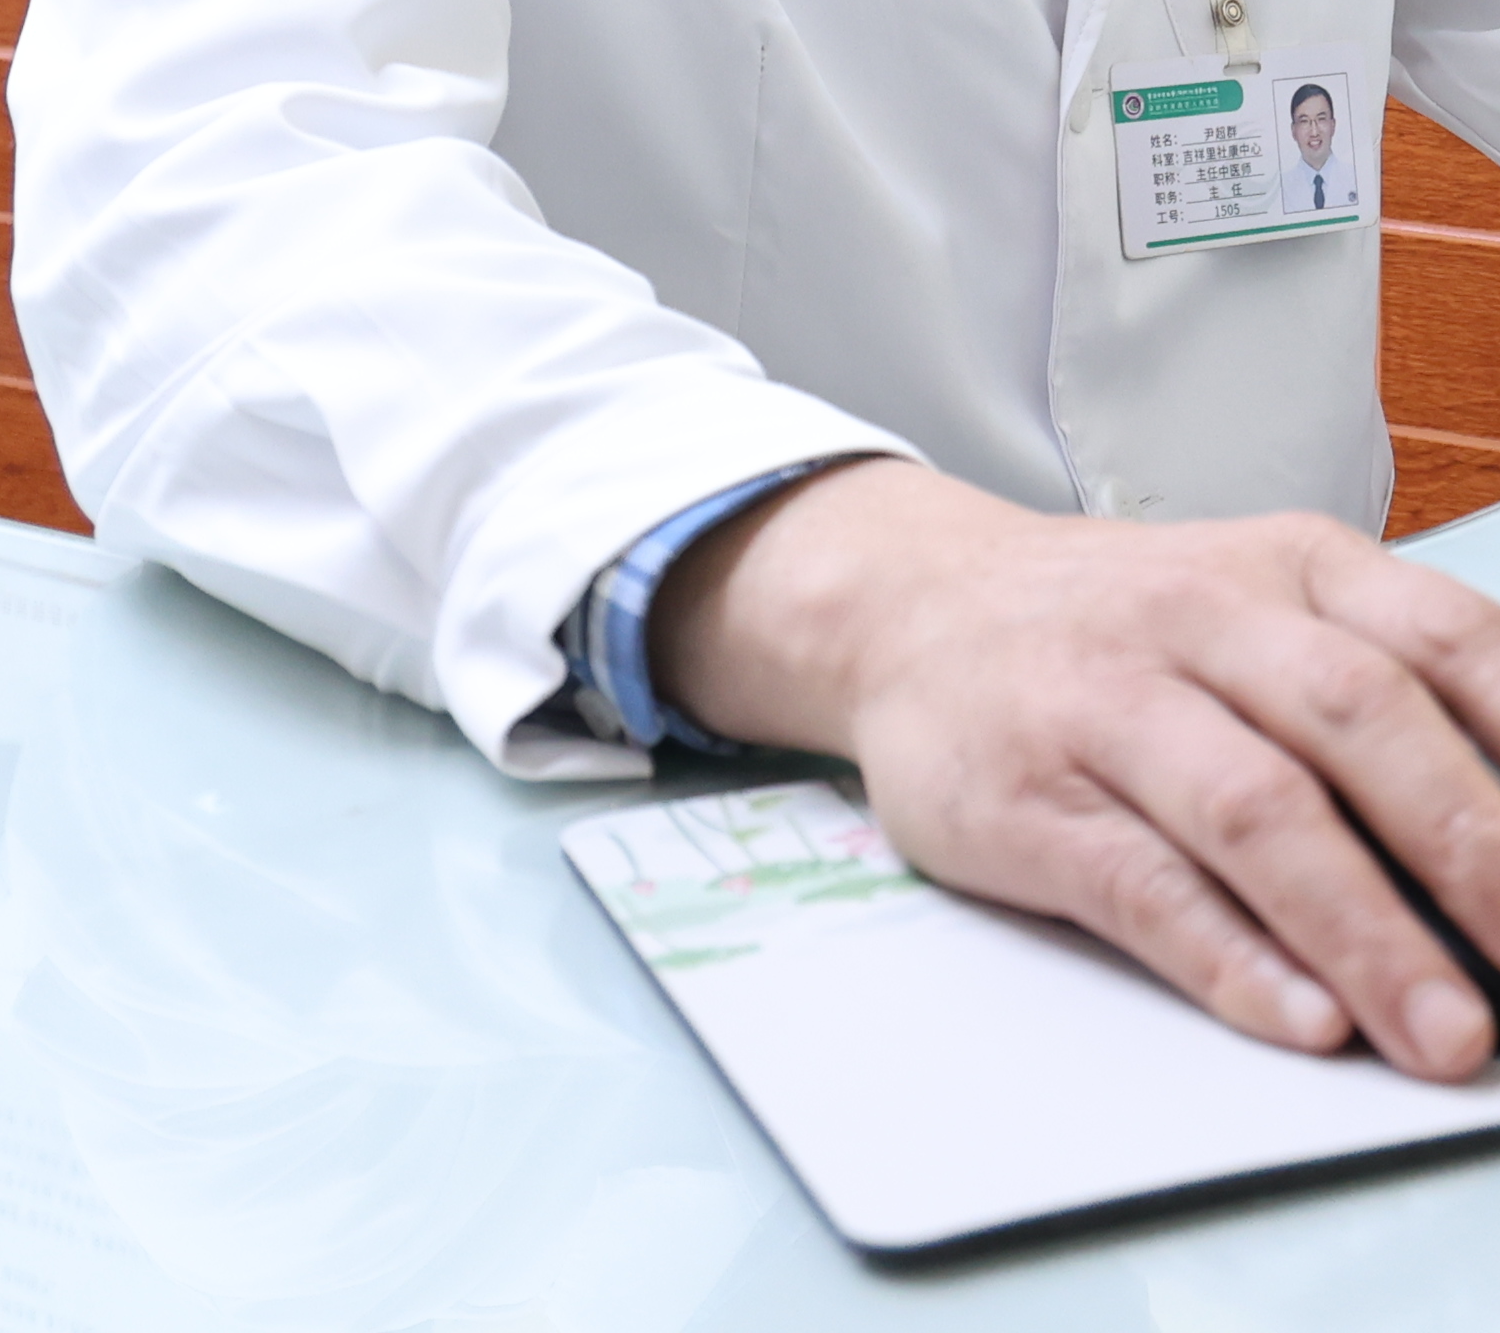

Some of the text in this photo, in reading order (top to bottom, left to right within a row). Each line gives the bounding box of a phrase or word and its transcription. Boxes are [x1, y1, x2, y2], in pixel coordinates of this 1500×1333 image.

[1150, 134, 1178, 148] 姓名：
[1152, 153, 1179, 167] 科室：
[1154, 163, 1251, 186] 职称： 主任中医师
[1155, 192, 1182, 205] 职务：
[1157, 204, 1240, 224] 工号： 1505
